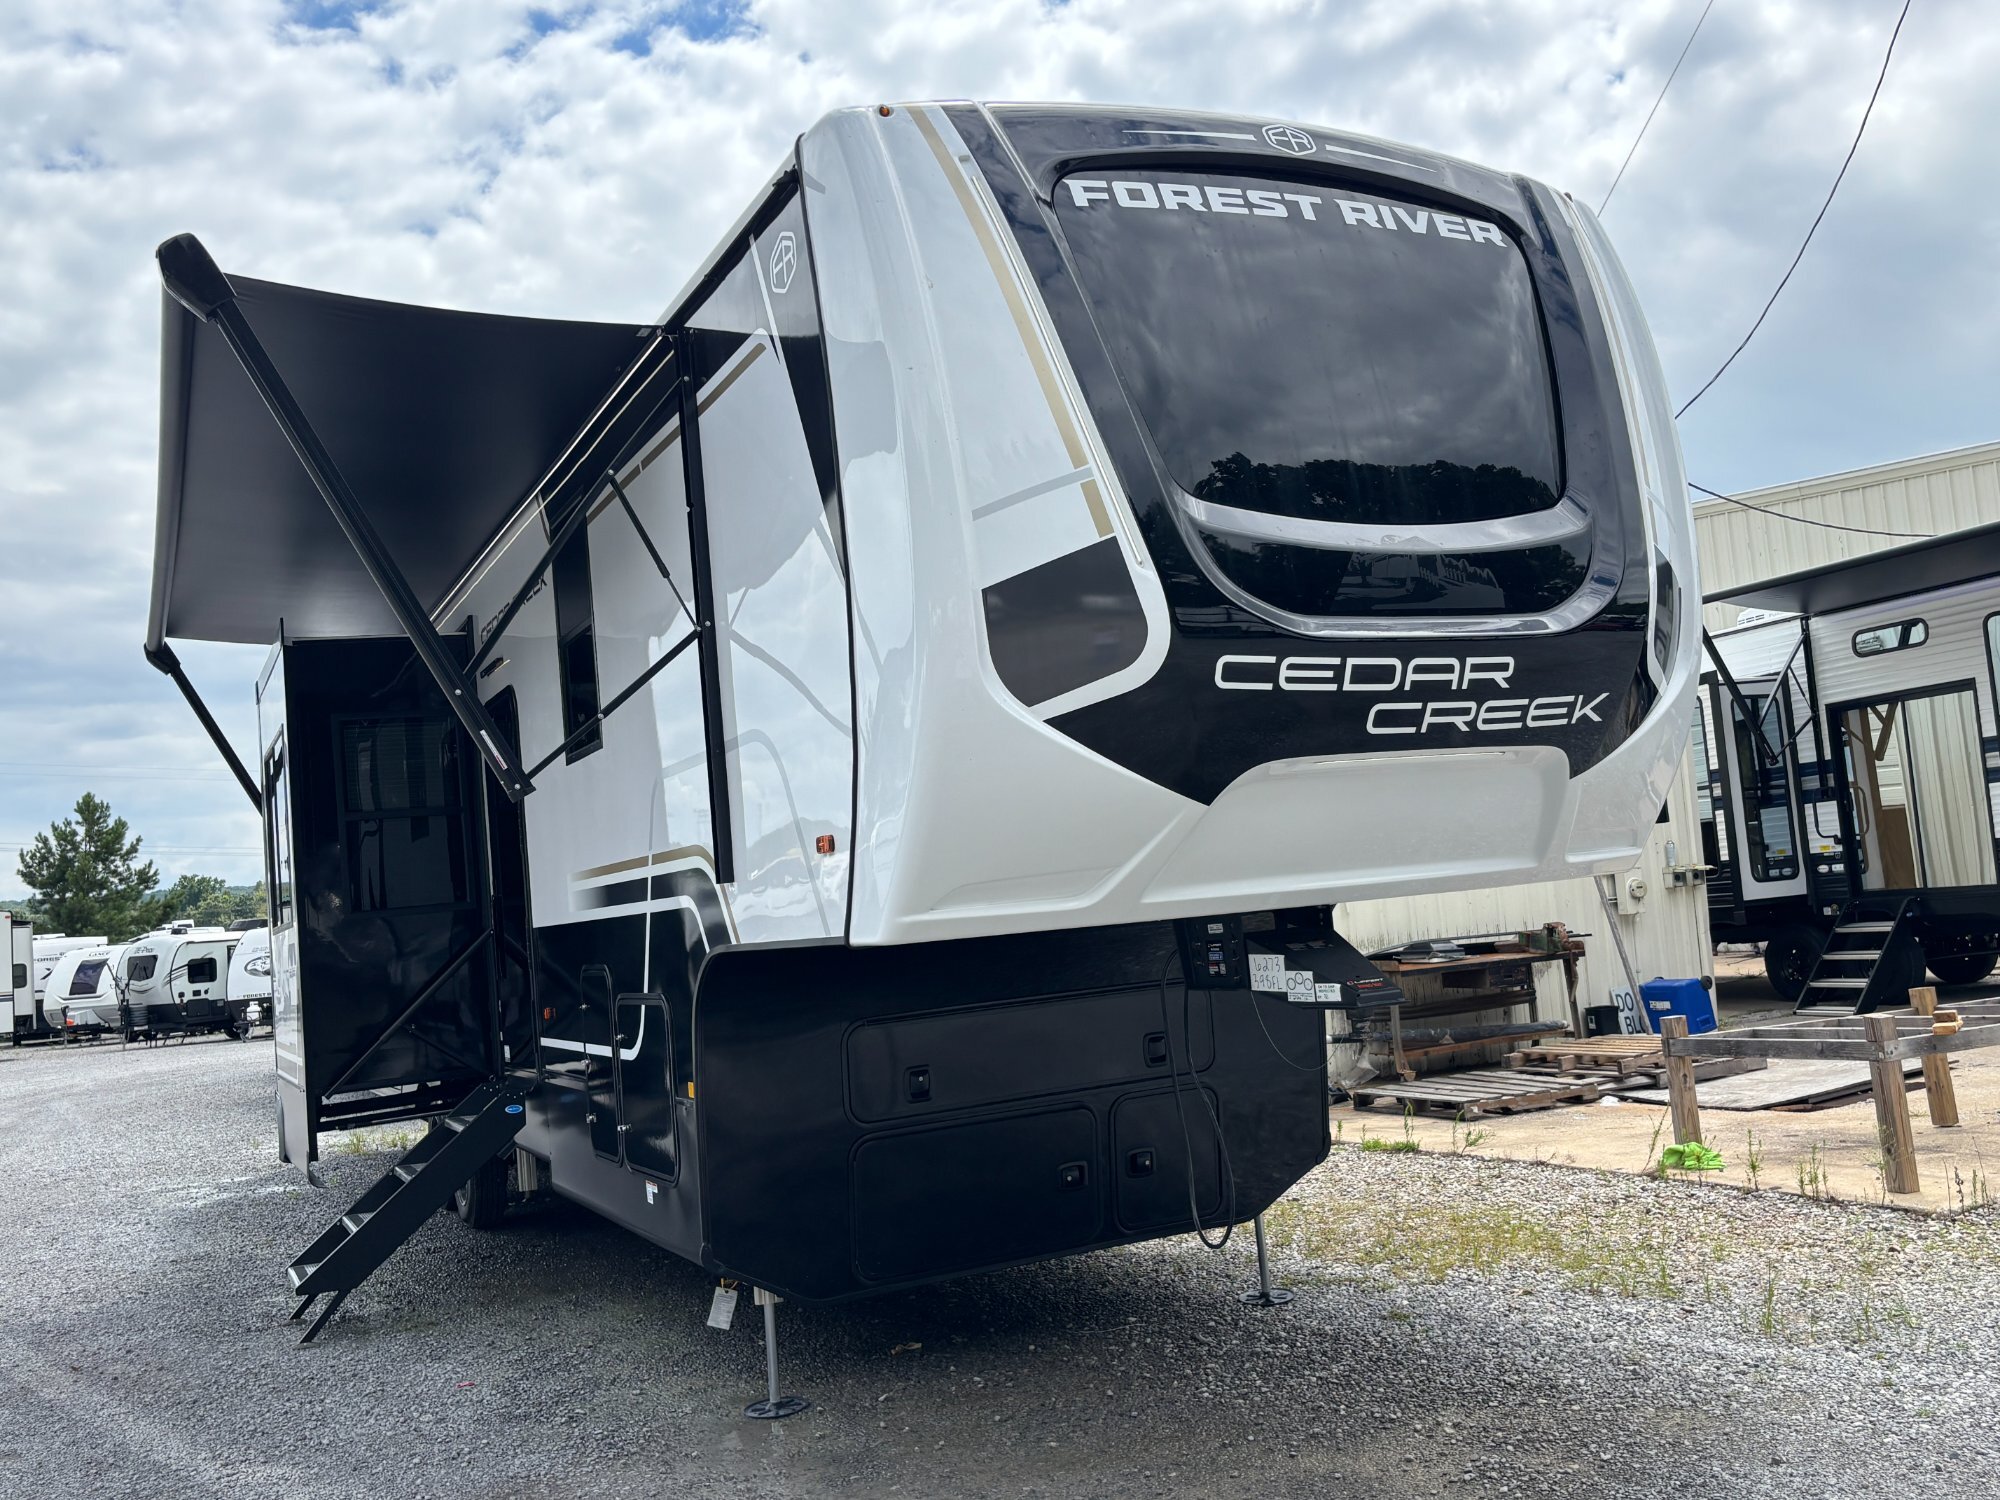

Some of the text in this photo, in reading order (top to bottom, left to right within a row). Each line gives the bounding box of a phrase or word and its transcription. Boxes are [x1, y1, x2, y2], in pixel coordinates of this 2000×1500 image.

[1061, 178, 1508, 248] FOREST RIVER
[1214, 654, 1515, 692] CEDAR
[1366, 692, 1611, 735] CREEK
[1615, 992, 1634, 1012] DO
